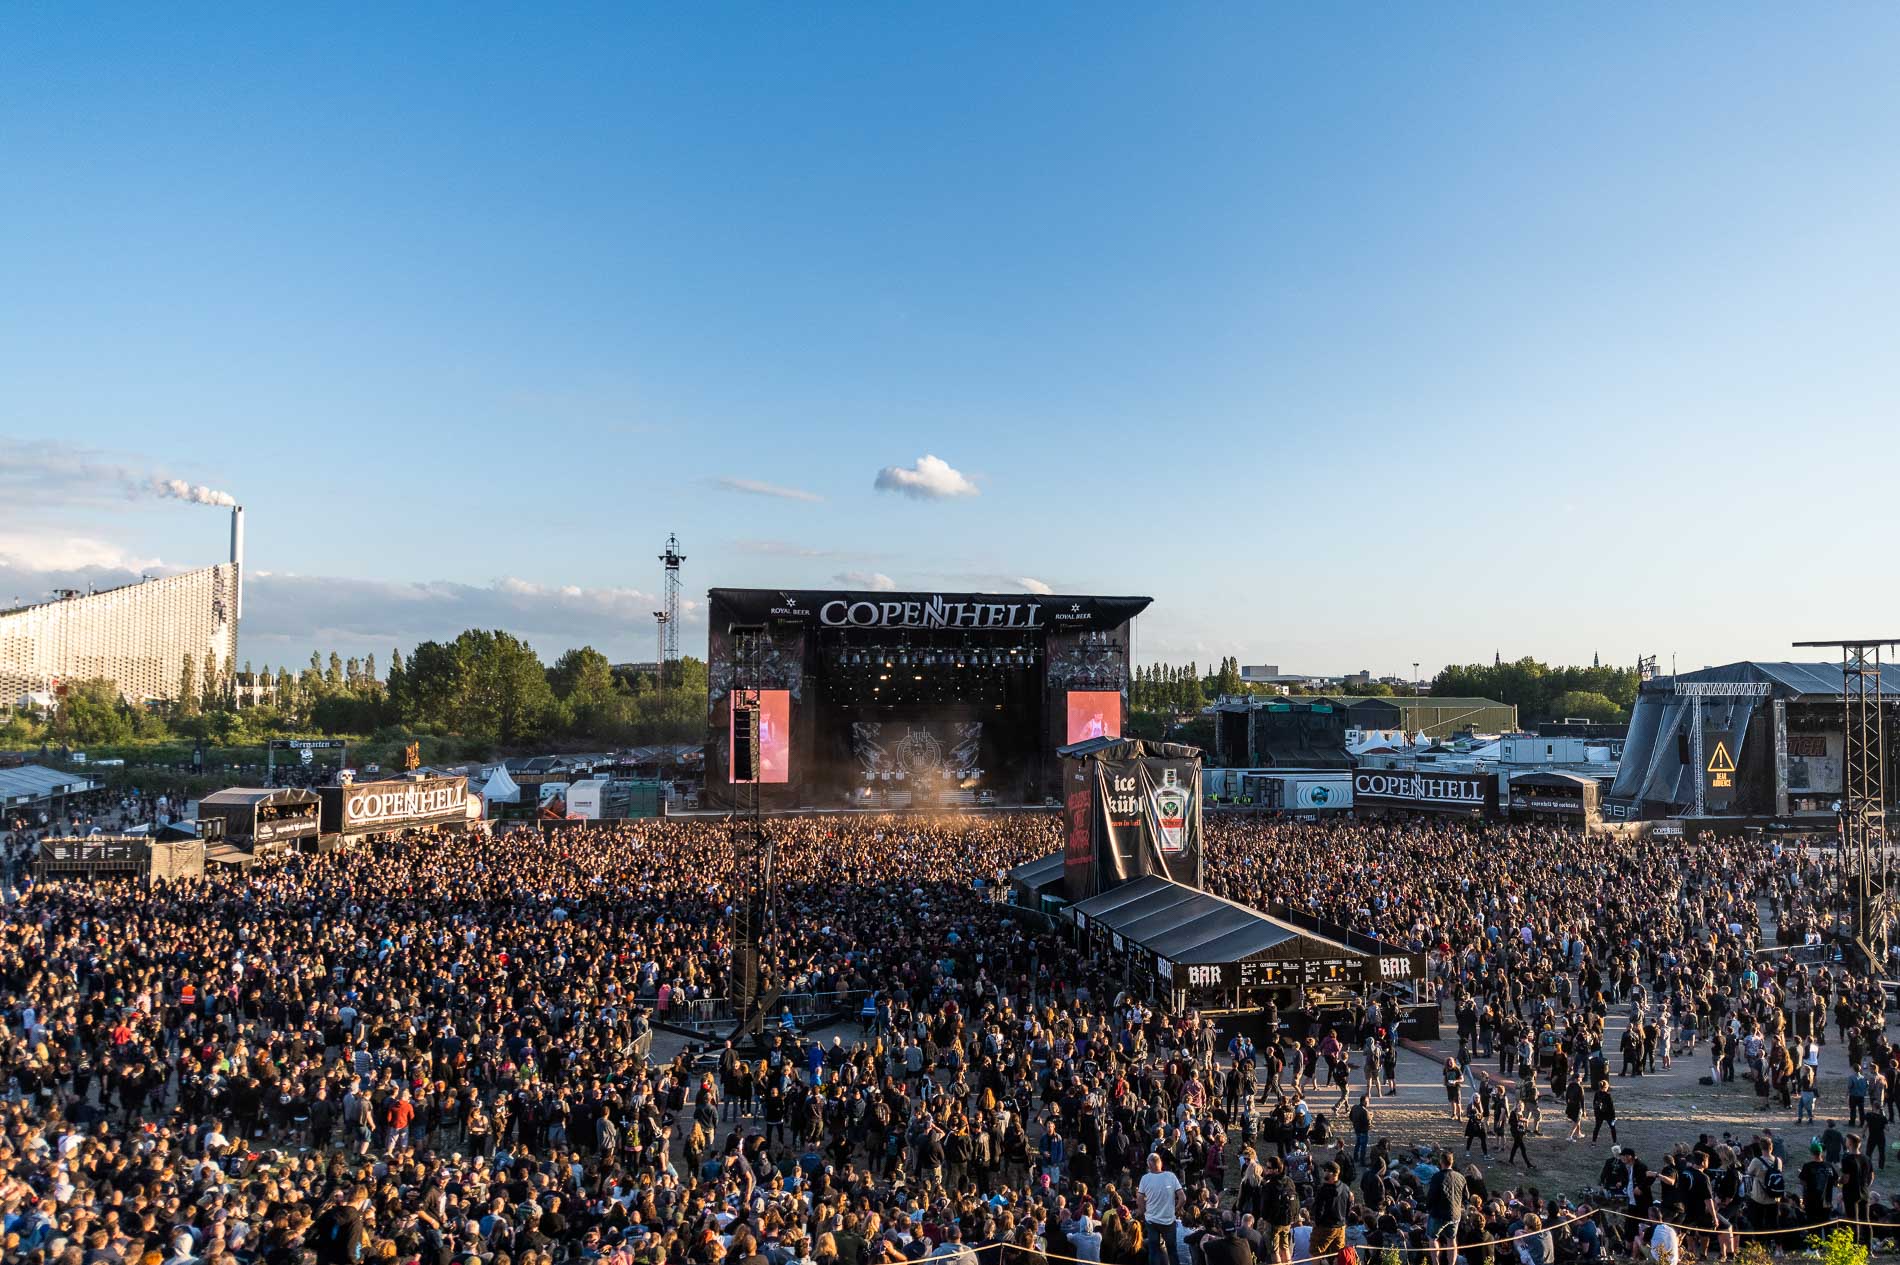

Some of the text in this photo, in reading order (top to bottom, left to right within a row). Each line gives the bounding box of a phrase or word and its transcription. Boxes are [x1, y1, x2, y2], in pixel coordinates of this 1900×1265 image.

[771, 607, 791, 615] ROYAL
[819, 595, 1045, 629] COPENHELL
[1114, 774, 1136, 792] ice
[1355, 774, 1485, 801] COPENHELL
[348, 785, 467, 819] COPENHELL
[1109, 795, 1145, 817] kühl
[1158, 956, 1172, 980] BAR
[1188, 965, 1222, 989] BAR
[1380, 957, 1411, 980] BAR
